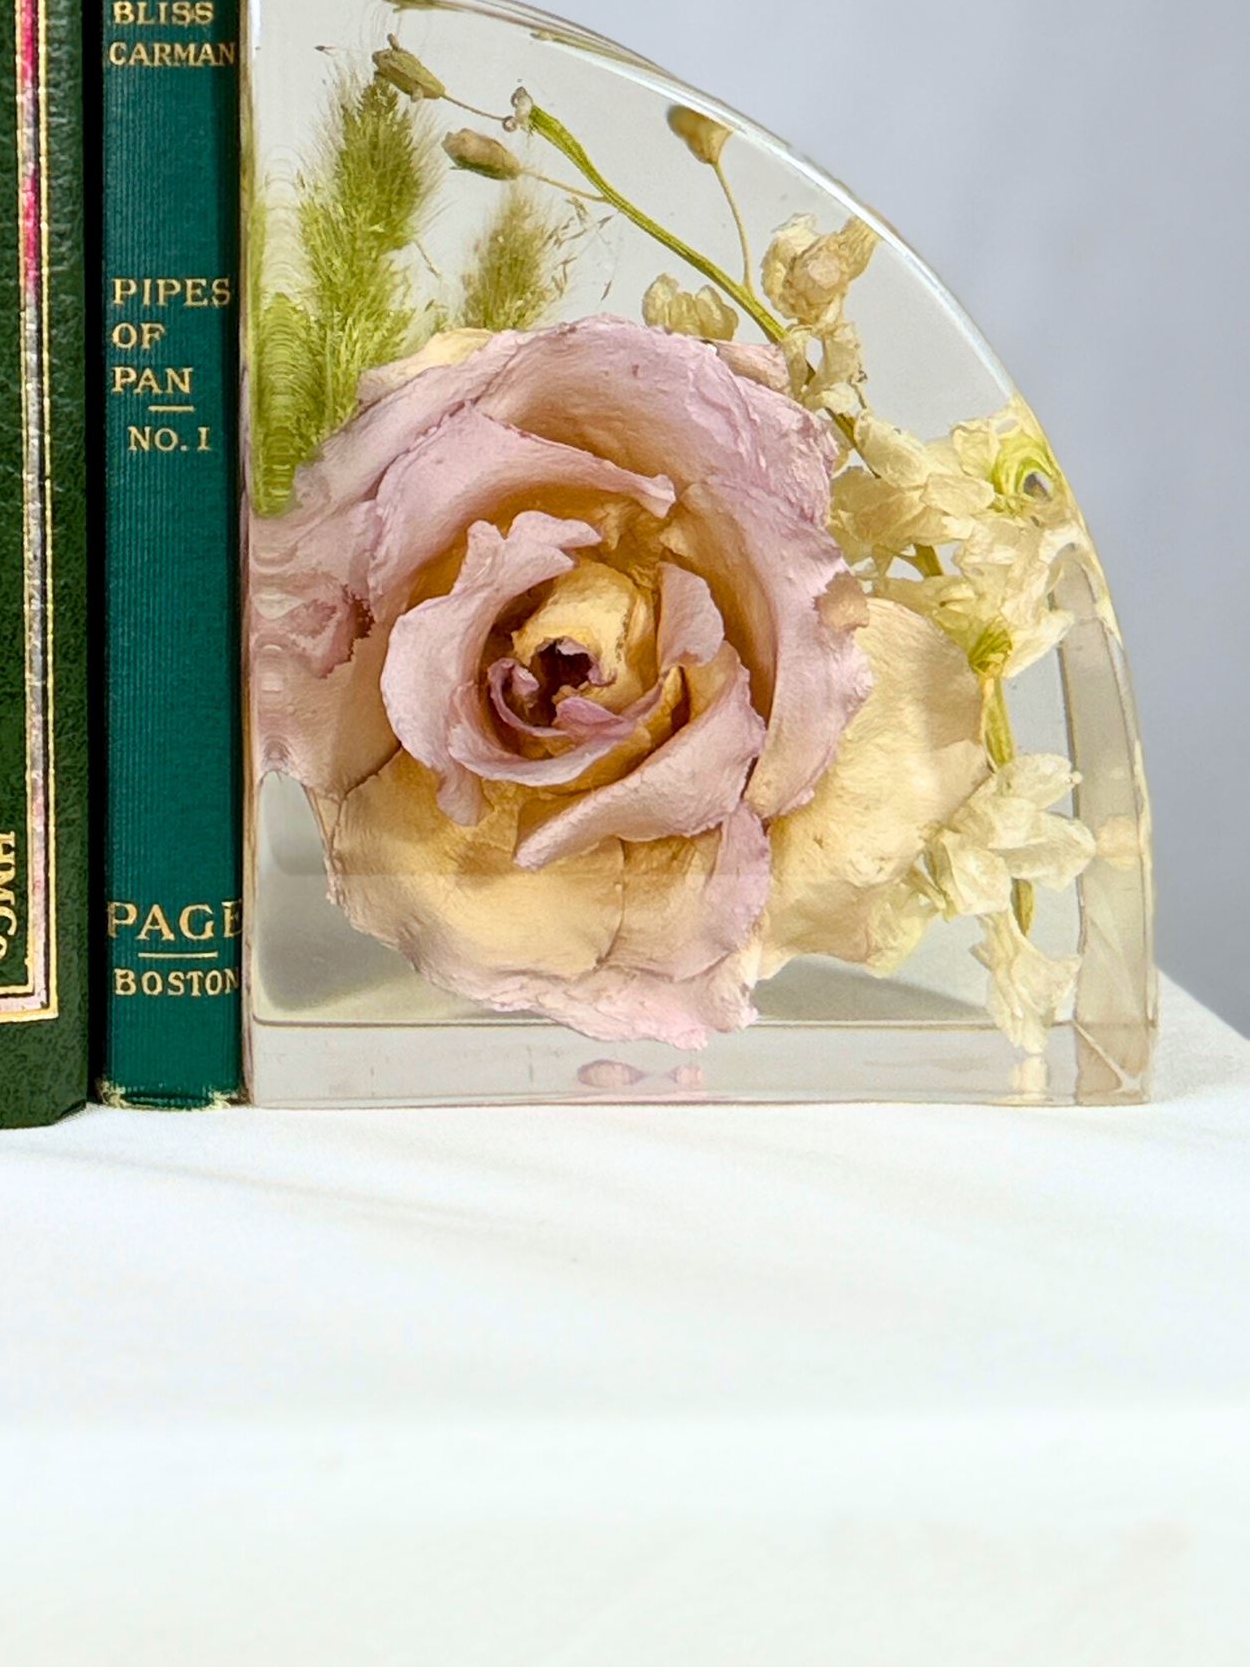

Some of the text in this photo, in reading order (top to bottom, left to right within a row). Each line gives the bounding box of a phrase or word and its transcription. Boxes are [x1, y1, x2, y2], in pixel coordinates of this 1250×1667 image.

[112, 0, 214, 26] BLISS
[108, 40, 238, 67] CARMAN
[111, 277, 232, 308] PIPES
[111, 321, 166, 350] OF
[111, 365, 194, 395] PAN
[126, 425, 190, 452] NO.
[113, 967, 239, 997] BOSTON
